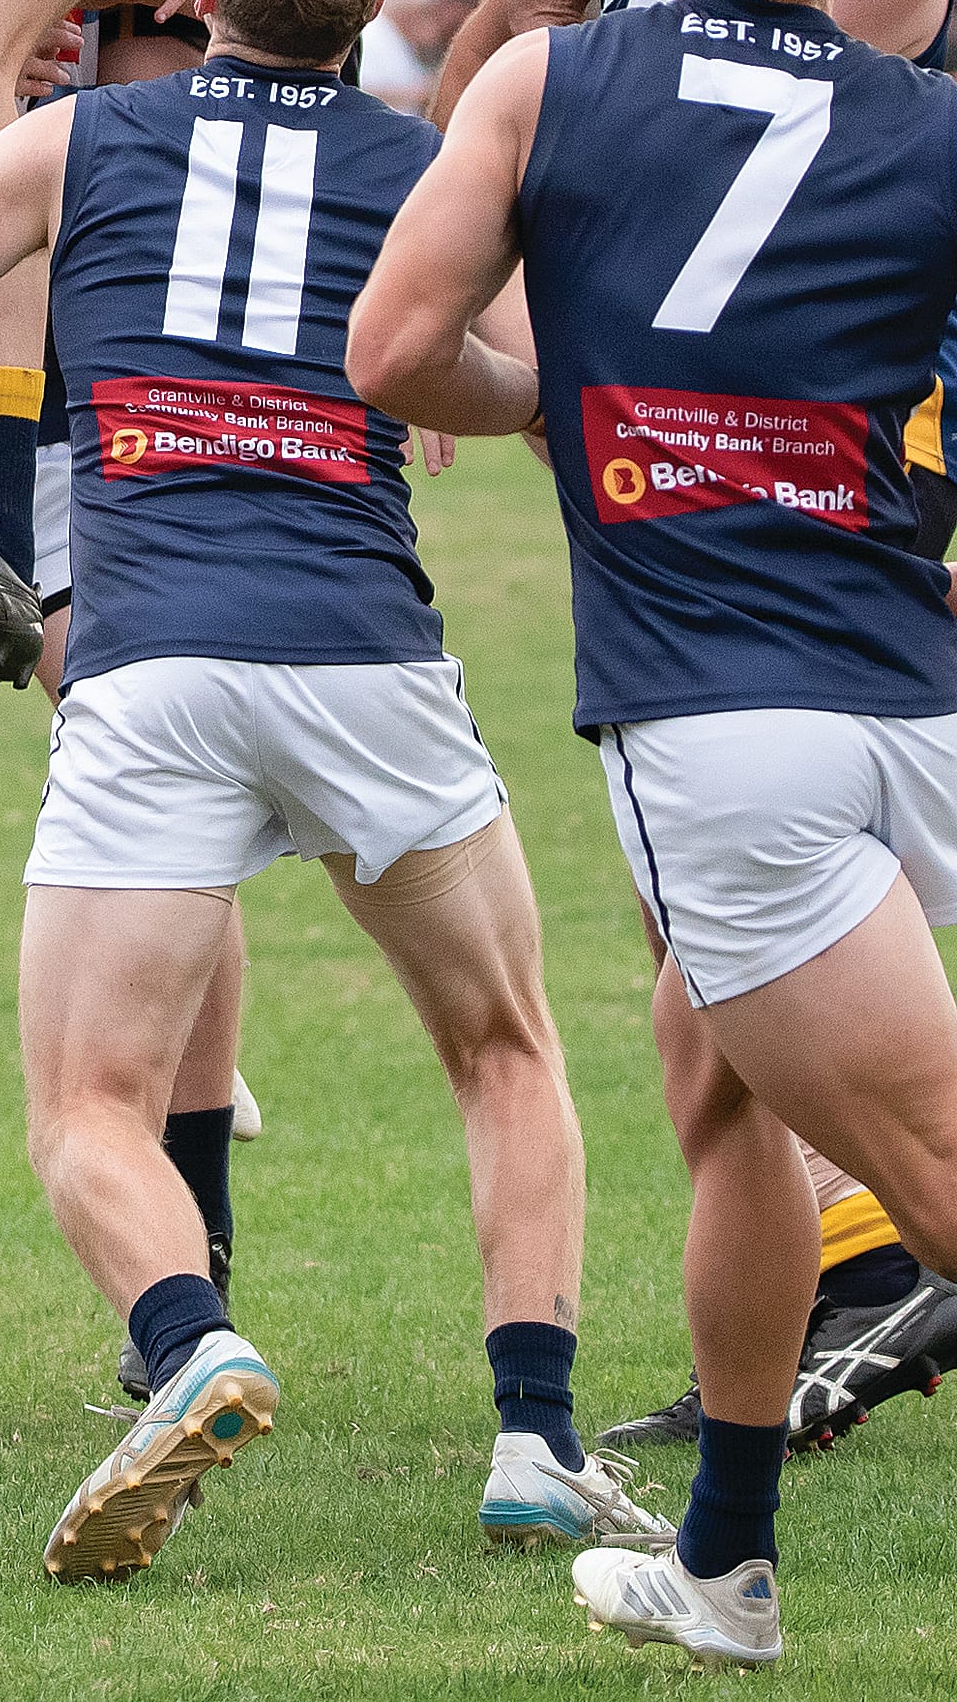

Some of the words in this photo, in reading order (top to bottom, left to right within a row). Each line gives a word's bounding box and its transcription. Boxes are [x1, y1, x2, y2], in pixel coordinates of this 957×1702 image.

[680, 13, 756, 44] EST.
[771, 28, 843, 61] 1957
[189, 75, 255, 99] EST.
[269, 82, 338, 109] 1957
[652, 53, 834, 334] 7
[162, 116, 318, 355] 11
[147, 388, 226, 406] Grantville
[231, 395, 245, 406] &
[249, 396, 309, 412] District
[276, 416, 334, 435] Branch
[634, 402, 720, 426] Grantville
[724, 410, 739, 427] &
[745, 411, 809, 432] District
[154, 431, 276, 461] Bendigo
[281, 437, 357, 463] Bank
[772, 436, 836, 456] Branch
[774, 481, 856, 511] Bank
